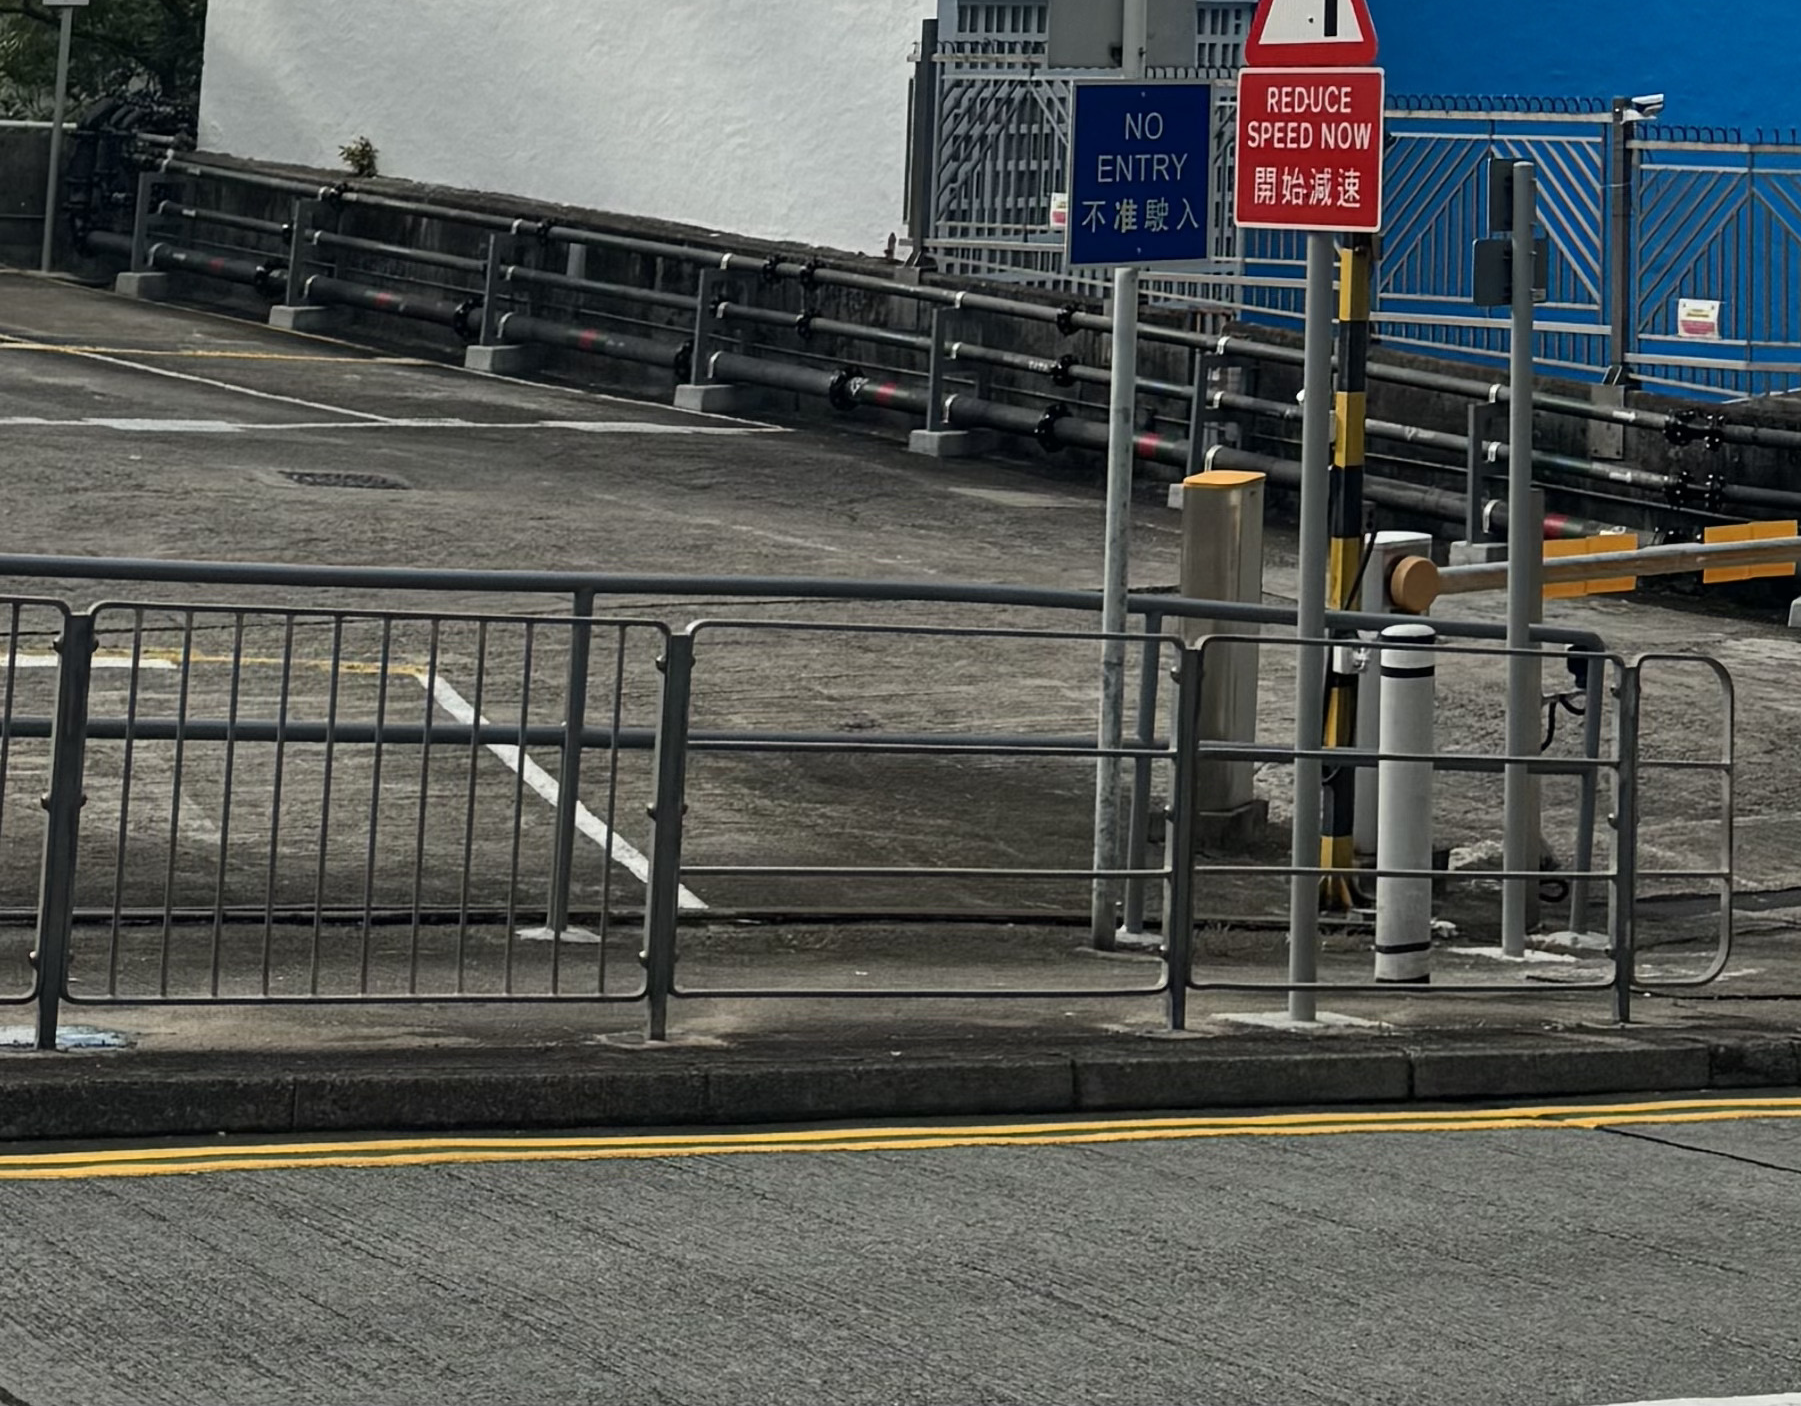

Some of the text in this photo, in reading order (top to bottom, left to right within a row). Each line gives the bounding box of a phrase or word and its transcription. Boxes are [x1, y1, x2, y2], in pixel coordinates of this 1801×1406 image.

[1267, 85, 1353, 114] REDUCE
[1125, 112, 1164, 140] NO
[1247, 121, 1372, 150] SPEED NOW
[1097, 153, 1188, 183] ENTRY
[1254, 165, 1362, 208] 開始減速
[1081, 197, 1199, 233] 不准駛入
